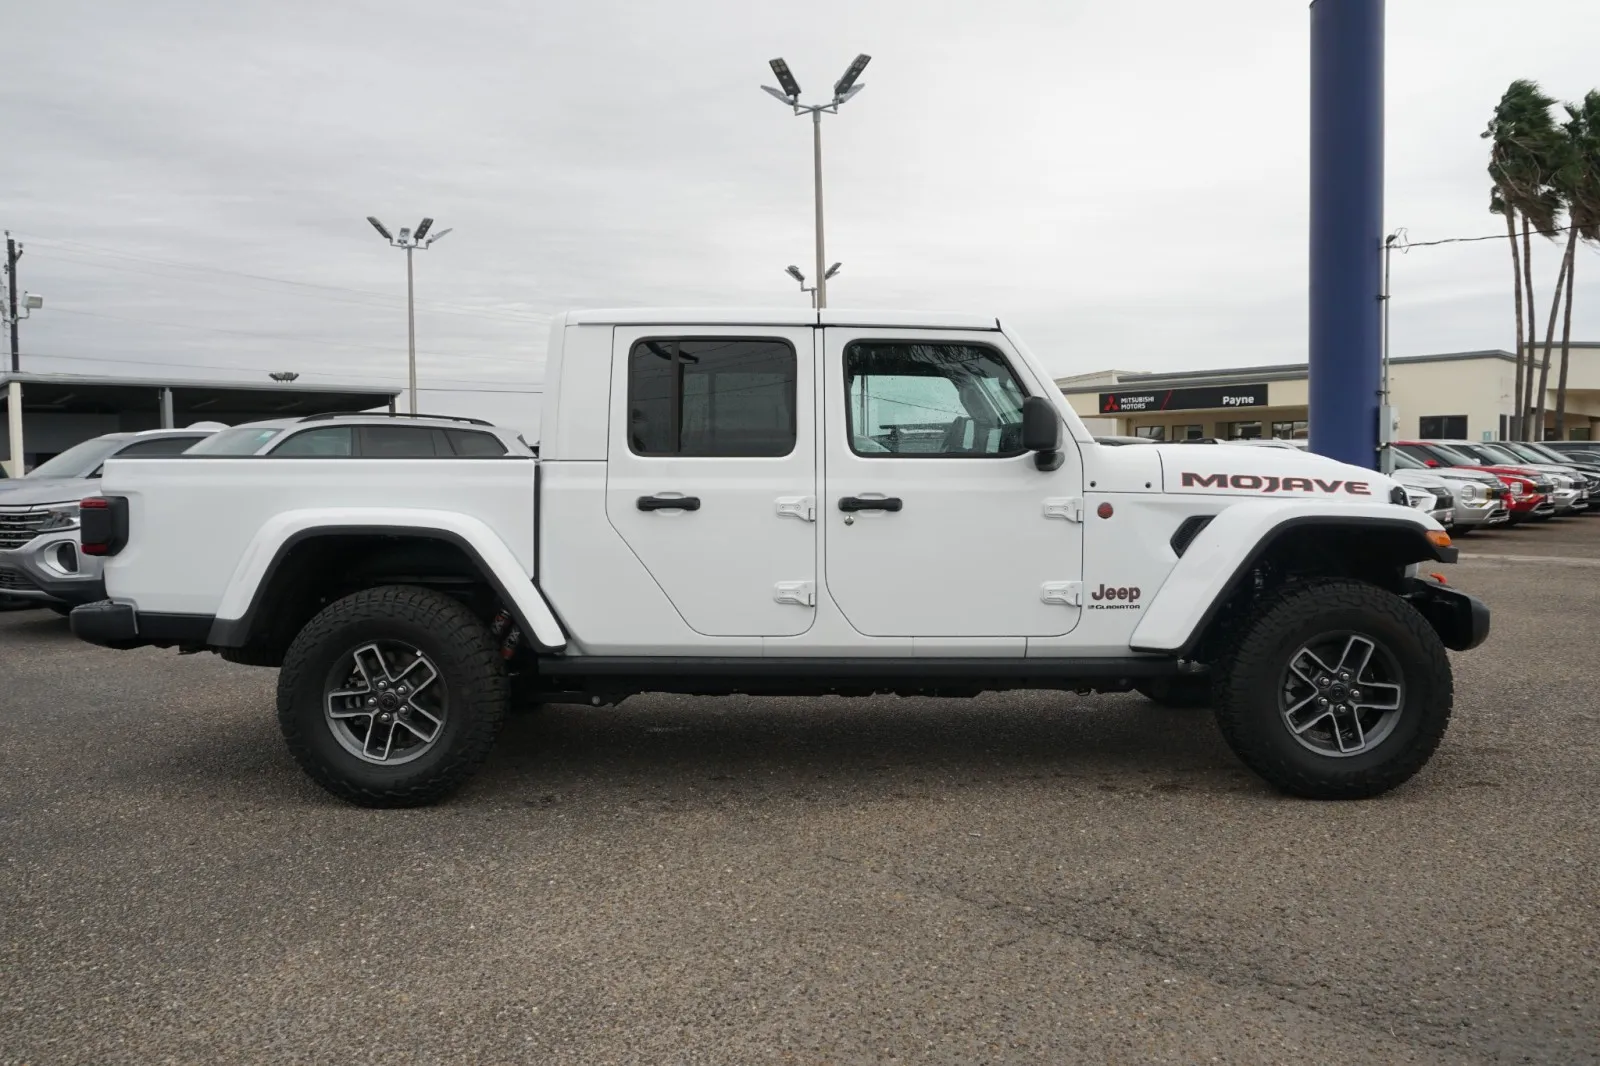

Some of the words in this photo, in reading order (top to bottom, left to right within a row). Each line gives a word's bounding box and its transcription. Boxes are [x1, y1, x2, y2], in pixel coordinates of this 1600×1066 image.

[1120, 396, 1155, 404] MITSUBISHI
[1222, 396, 1254, 407] Payne
[1181, 472, 1372, 495] MOJAVE
[1091, 583, 1141, 603] Jeep
